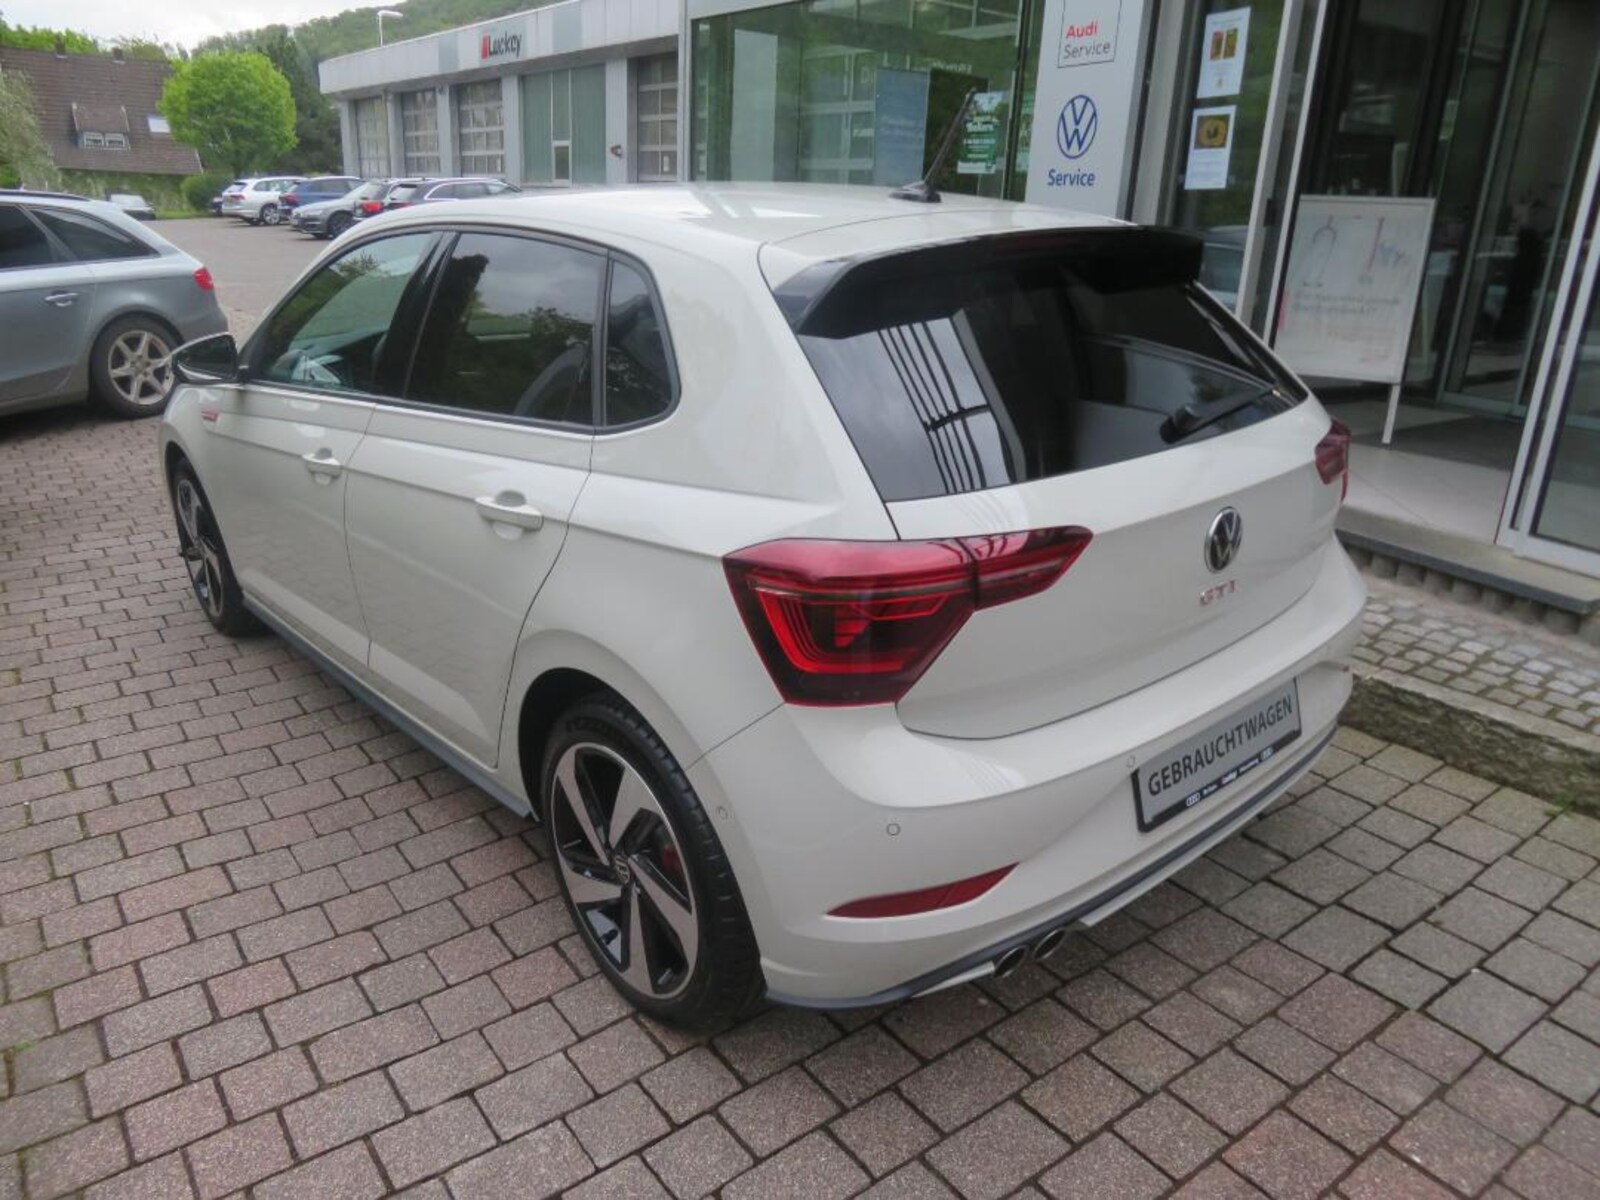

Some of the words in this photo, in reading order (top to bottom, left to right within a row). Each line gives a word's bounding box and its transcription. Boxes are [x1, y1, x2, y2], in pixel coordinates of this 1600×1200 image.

[1065, 20, 1098, 39] Audi
[1063, 40, 1111, 60] Service
[1047, 168, 1096, 187] Service
[1199, 580, 1236, 606] GTI
[1148, 694, 1293, 796] GEBRAUCHTWAGEN
